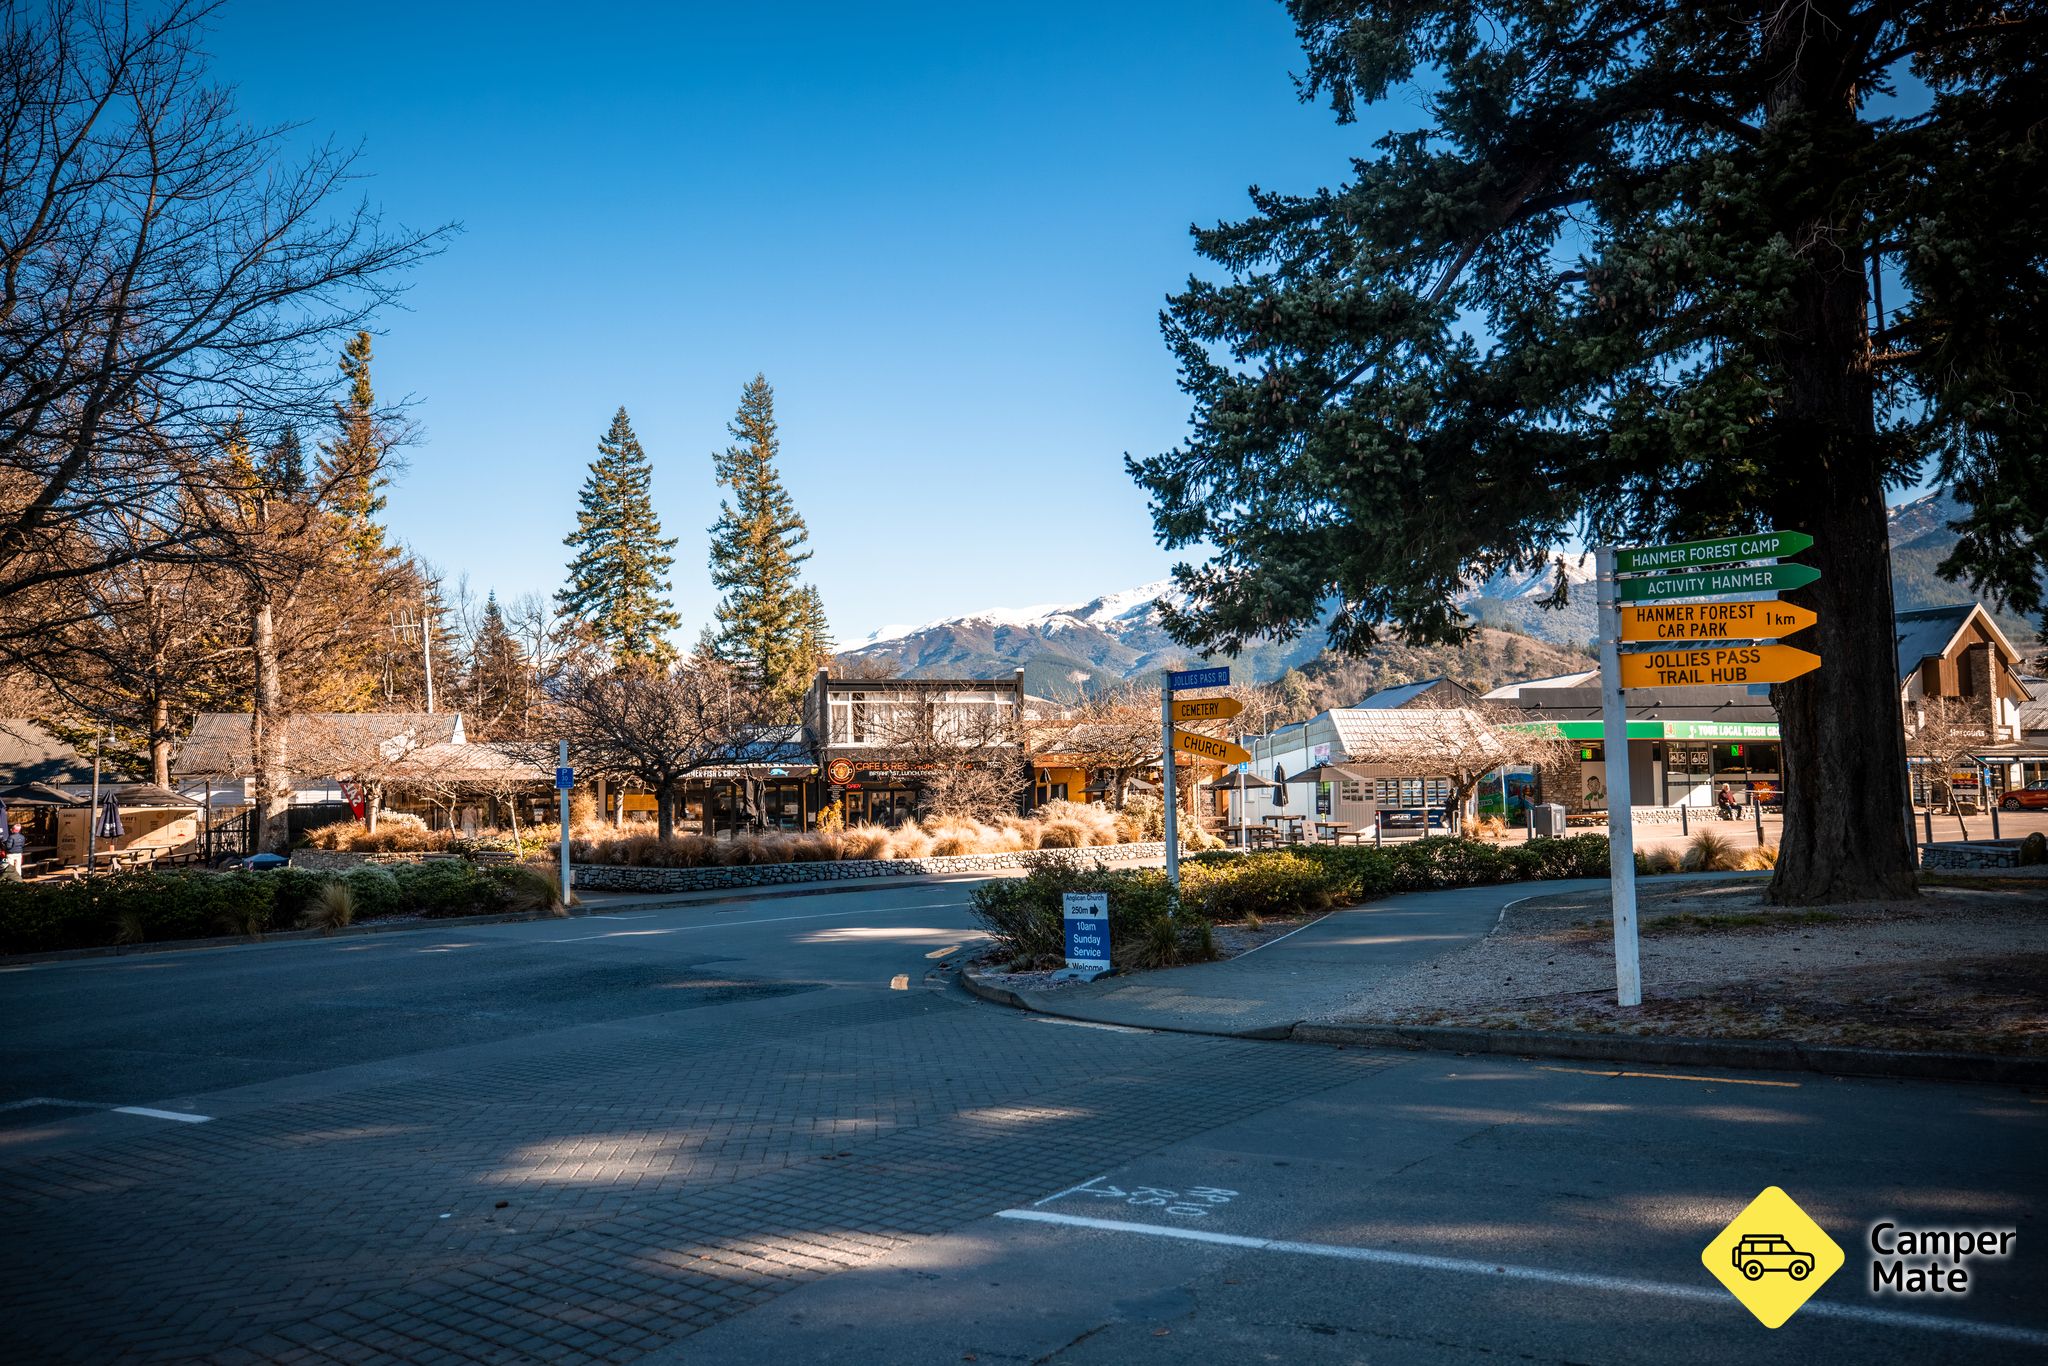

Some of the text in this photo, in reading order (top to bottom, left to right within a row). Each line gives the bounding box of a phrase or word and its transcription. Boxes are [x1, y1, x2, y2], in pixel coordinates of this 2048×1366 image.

[1632, 538, 1780, 567] HANMER FOREST CAMP
[1648, 572, 1773, 595] ACTIVITY HANMER
[1637, 604, 1796, 626] HANMER FOREST 1 km
[1658, 622, 1728, 638] CAR PARK
[1645, 649, 1761, 669] JOLLIES PASS
[1173, 672, 1227, 686] JOLLIES PASS RD
[1658, 667, 1747, 685] TRAIL HUB
[1181, 702, 1219, 717] CEMETERY
[1698, 725, 1718, 736] YOUR
[1720, 725, 1742, 736] LOCAL
[1744, 726, 1765, 736] FRESH
[1184, 736, 1226, 757] CHURCH
[855, 762, 880, 770] CAFE
[882, 762, 889, 770] &
[1066, 894, 1085, 902] Anglican
[1071, 906, 1088, 914] 250m
[1077, 921, 1096, 931] 10am
[1073, 933, 1101, 945] Sunday
[1073, 946, 1101, 957] Service
